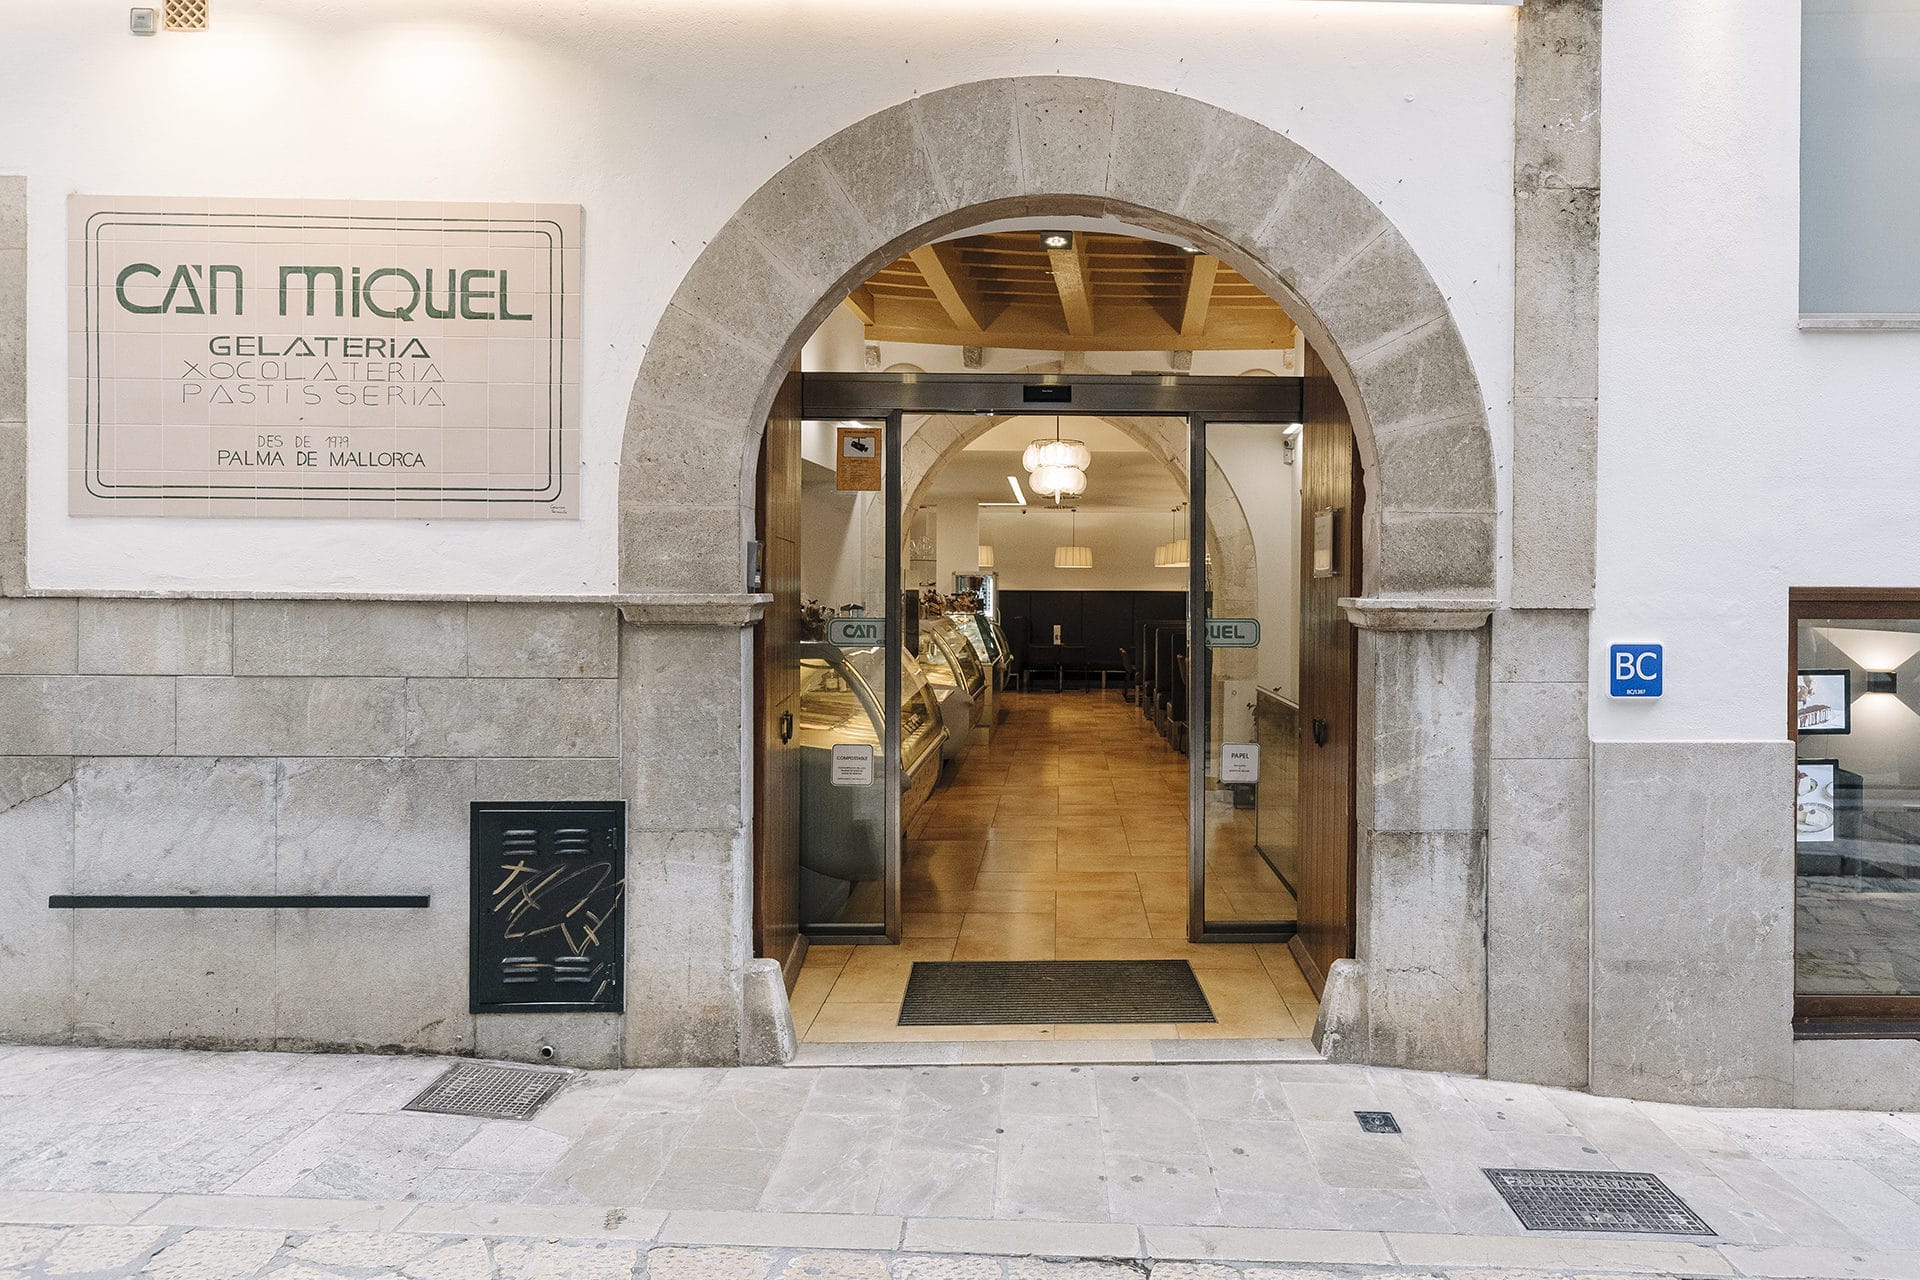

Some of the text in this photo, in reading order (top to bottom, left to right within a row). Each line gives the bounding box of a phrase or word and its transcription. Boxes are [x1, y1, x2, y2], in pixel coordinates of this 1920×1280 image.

[209, 336, 430, 358] GELATERIA
[182, 360, 446, 382] XOCOLATERIA
[258, 435, 349, 448] DES DE 1979
[218, 450, 426, 467] PALMA DE MALLORCA
[1616, 652, 1657, 680] BC
[1231, 752, 1250, 760] PAPEL
